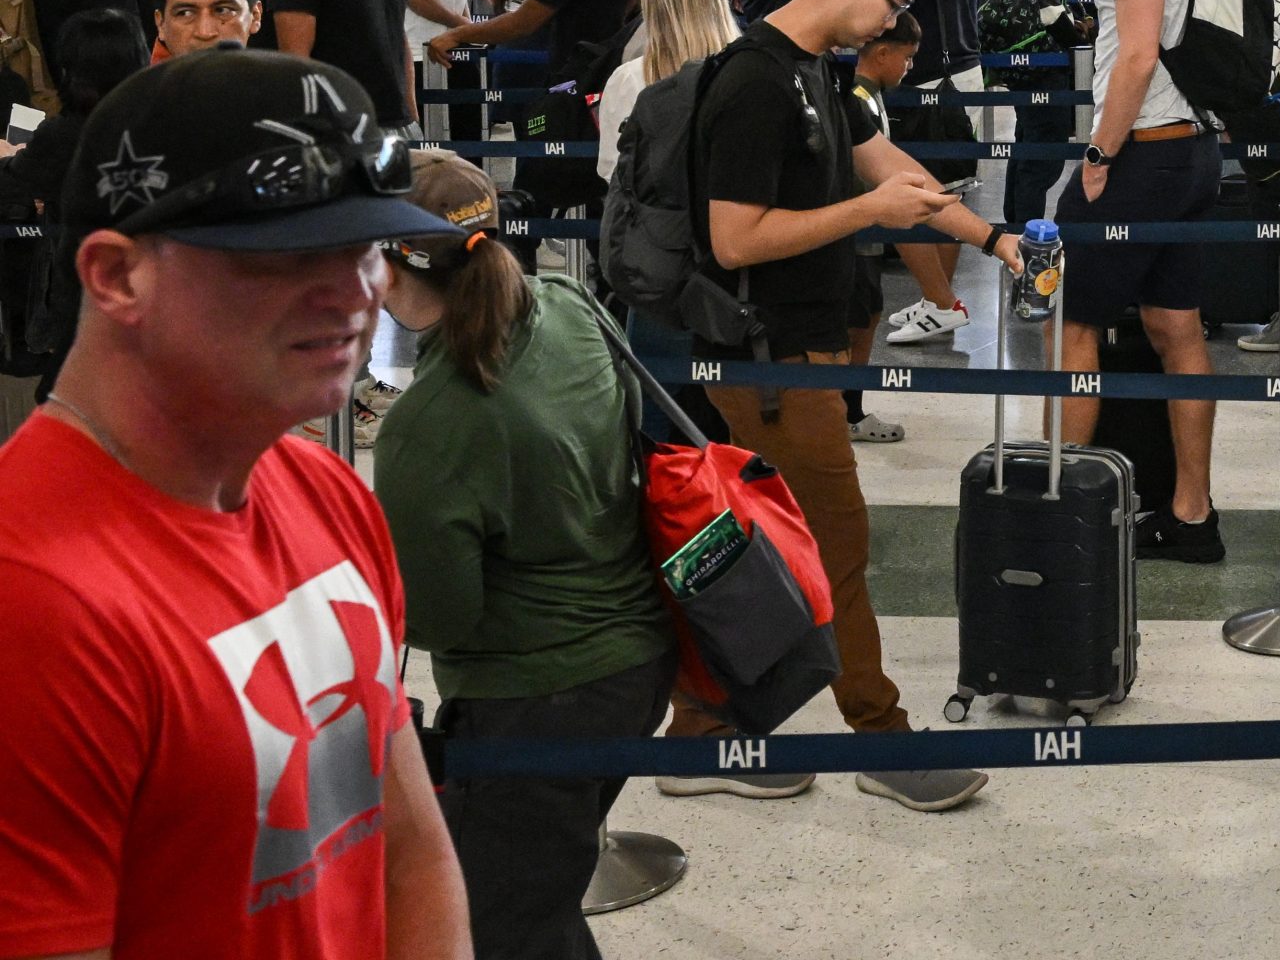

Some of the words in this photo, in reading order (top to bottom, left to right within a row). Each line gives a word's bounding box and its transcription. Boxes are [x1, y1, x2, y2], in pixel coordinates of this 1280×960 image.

[1011, 54, 1029, 65] IAH
[485, 91, 502, 101] IAH
[922, 94, 938, 105] IAH
[1032, 93, 1049, 104] IAH
[545, 142, 565, 155] IAH
[991, 145, 1010, 157] IAH
[1247, 145, 1267, 157] IAH
[15, 226, 42, 238] IAH
[505, 220, 529, 235] IAH
[1105, 225, 1129, 240] IAH
[1256, 224, 1280, 238] IAH
[691, 362, 721, 381] IAH
[881, 368, 911, 388] IAH
[1071, 374, 1101, 393] IAH
[685, 538, 740, 586] GHIRARDELLI
[1034, 731, 1081, 760] IAH
[719, 738, 766, 768] IAH
